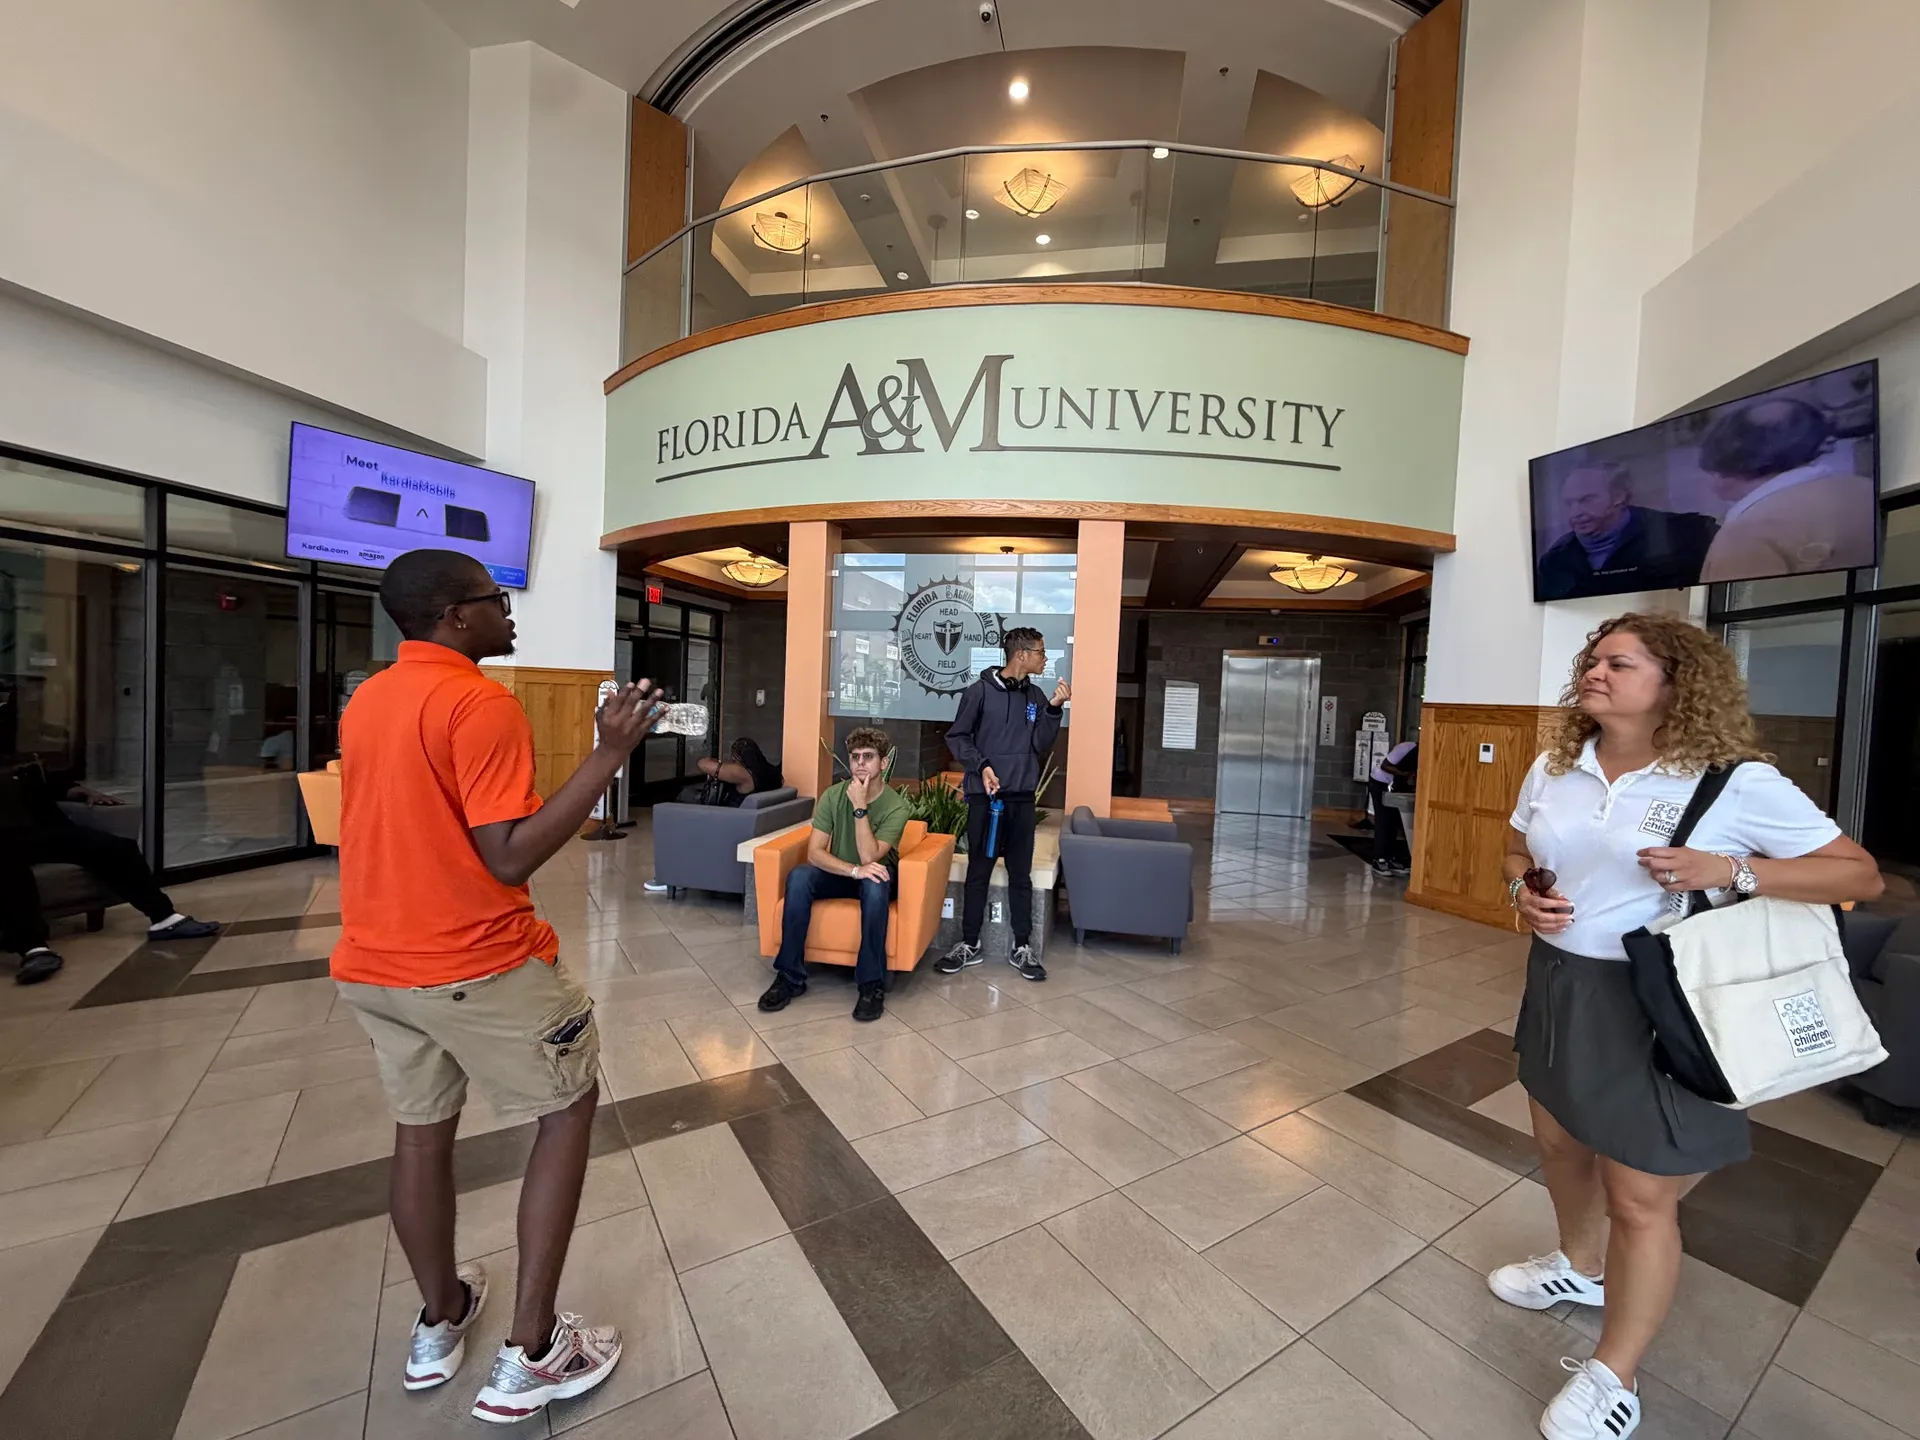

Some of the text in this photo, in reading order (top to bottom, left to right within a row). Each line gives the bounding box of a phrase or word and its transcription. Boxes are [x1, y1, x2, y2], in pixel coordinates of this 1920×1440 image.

[657, 353, 1347, 464] FLORIDA A&M UNIVERSITY
[346, 455, 380, 472] Meet
[301, 541, 350, 556] Kardia.com
[358, 550, 385, 562] amazon
[905, 590, 939, 623] FLORIDA
[901, 644, 936, 684] MECHANICAL
[938, 660, 956, 668] FIELD
[1644, 821, 1676, 835] childr
[1648, 816, 1676, 828] voices
[1790, 1019, 1824, 1036] voices for
[1794, 1030, 1830, 1046] children
